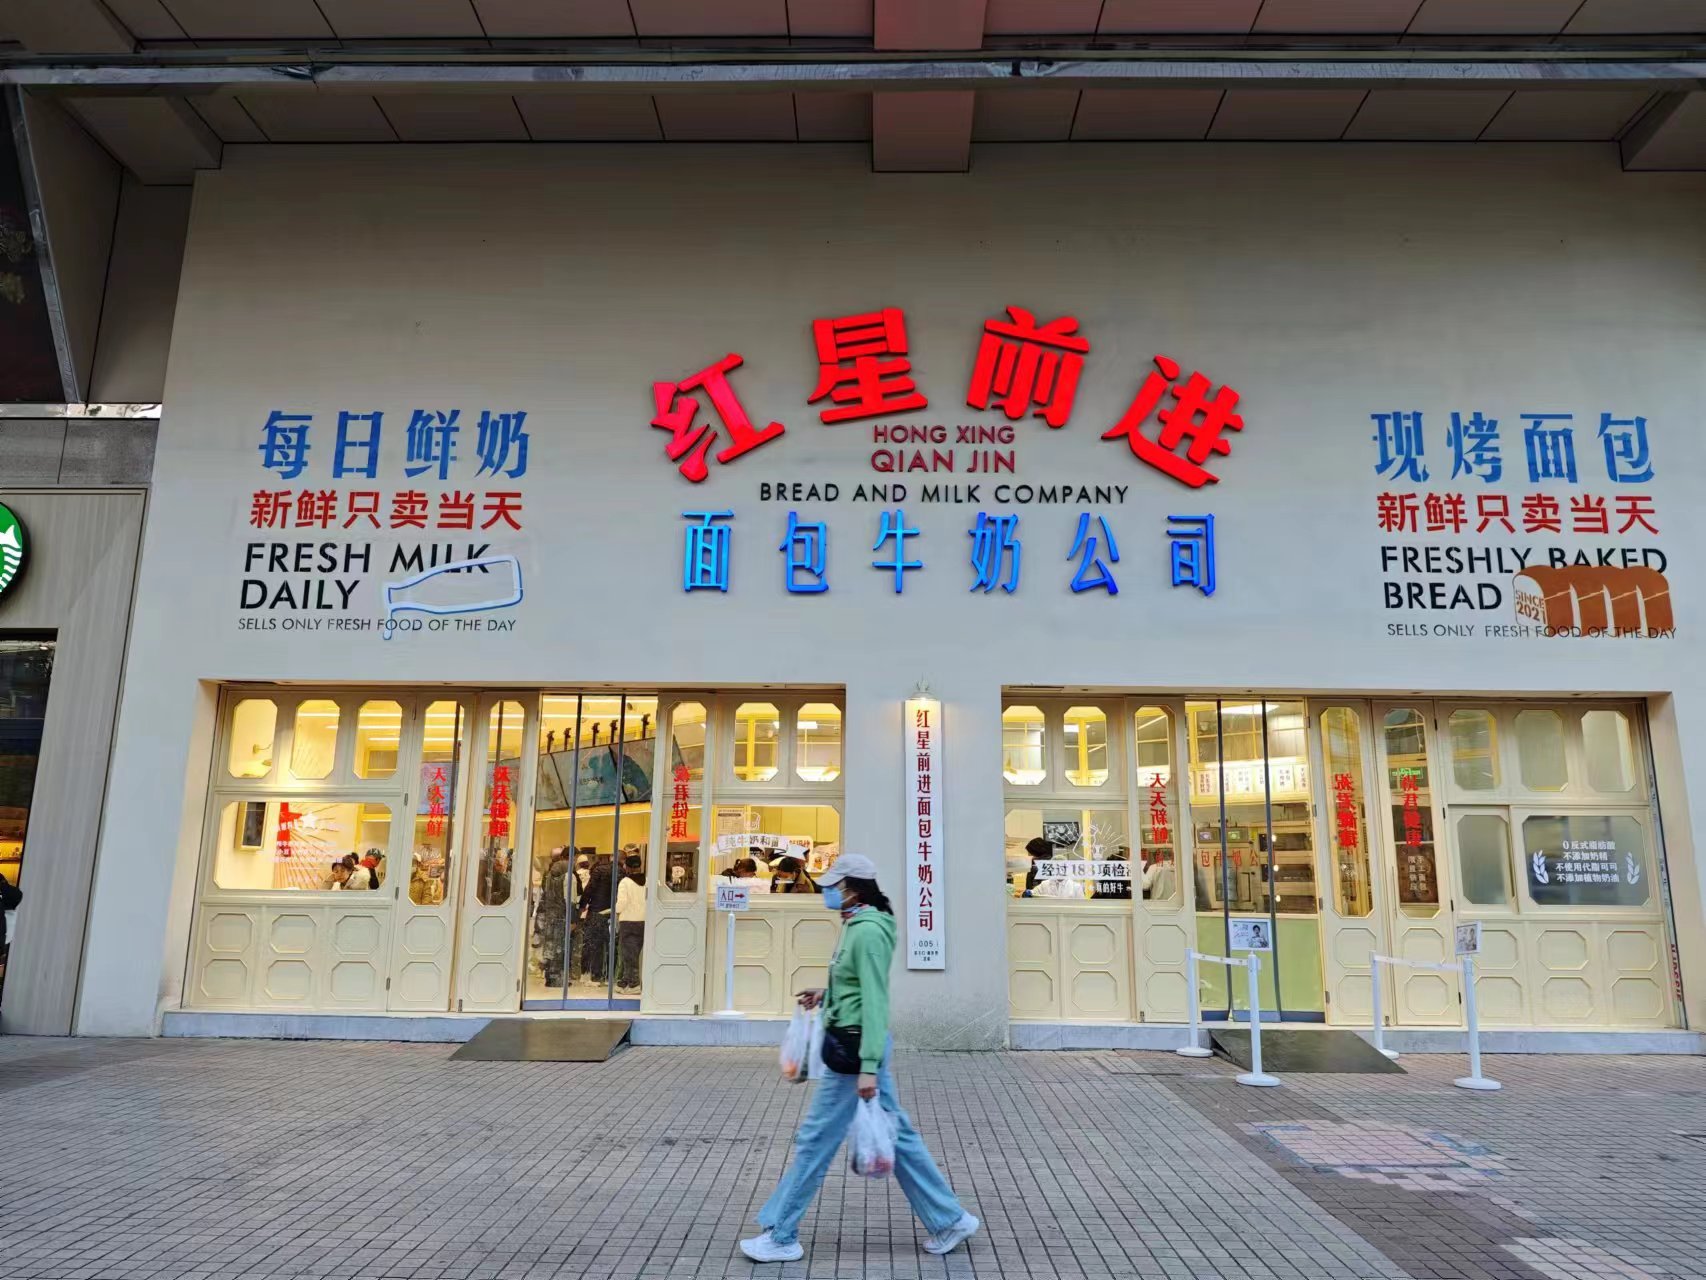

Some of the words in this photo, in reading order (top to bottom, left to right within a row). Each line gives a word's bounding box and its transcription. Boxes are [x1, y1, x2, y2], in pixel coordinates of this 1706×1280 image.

[650, 306, 1245, 489] 红星前进
[258, 409, 530, 480] 每日鲜奶
[873, 425, 947, 445] HONG
[955, 425, 1016, 445] XING
[1370, 411, 1655, 484] 现烤面包
[871, 449, 954, 475] QIAN
[967, 450, 1017, 474] JIN
[760, 482, 840, 502] BREAD
[852, 483, 908, 503] AND
[921, 484, 981, 504] MILK
[994, 485, 1129, 504] COMPANY
[249, 490, 523, 531] 新鲜只卖当天
[1376, 491, 1660, 535] 新鲜只卖当天
[244, 542, 371, 573] FRESH
[389, 543, 491, 574] MILK
[682, 509, 1217, 595] 面包牛奶公司
[1381, 546, 1532, 574] FRESHLY
[1548, 547, 1668, 575] BAKED
[239, 579, 361, 610] DAILY
[1383, 581, 1503, 611] BREAD
[1515, 590, 1545, 610] SINCE
[238, 618, 277, 631] SELLS
[282, 618, 322, 631] ONLY
[327, 618, 372, 631] FRESH
[377, 618, 423, 631] FOOD
[428, 619, 449, 631] OF
[454, 619, 482, 631] THE
[487, 619, 517, 632] DAY
[1387, 623, 1428, 637] SELLS
[1433, 623, 1475, 637] ONLY
[1484, 624, 1530, 638] FRESH
[1536, 625, 1582, 639] FOOD
[1588, 626, 1609, 639] OF
[1614, 626, 1643, 639] THE
[1648, 627, 1677, 640] DAY
[916, 709, 933, 931] 红星前进面包牛奶公司
